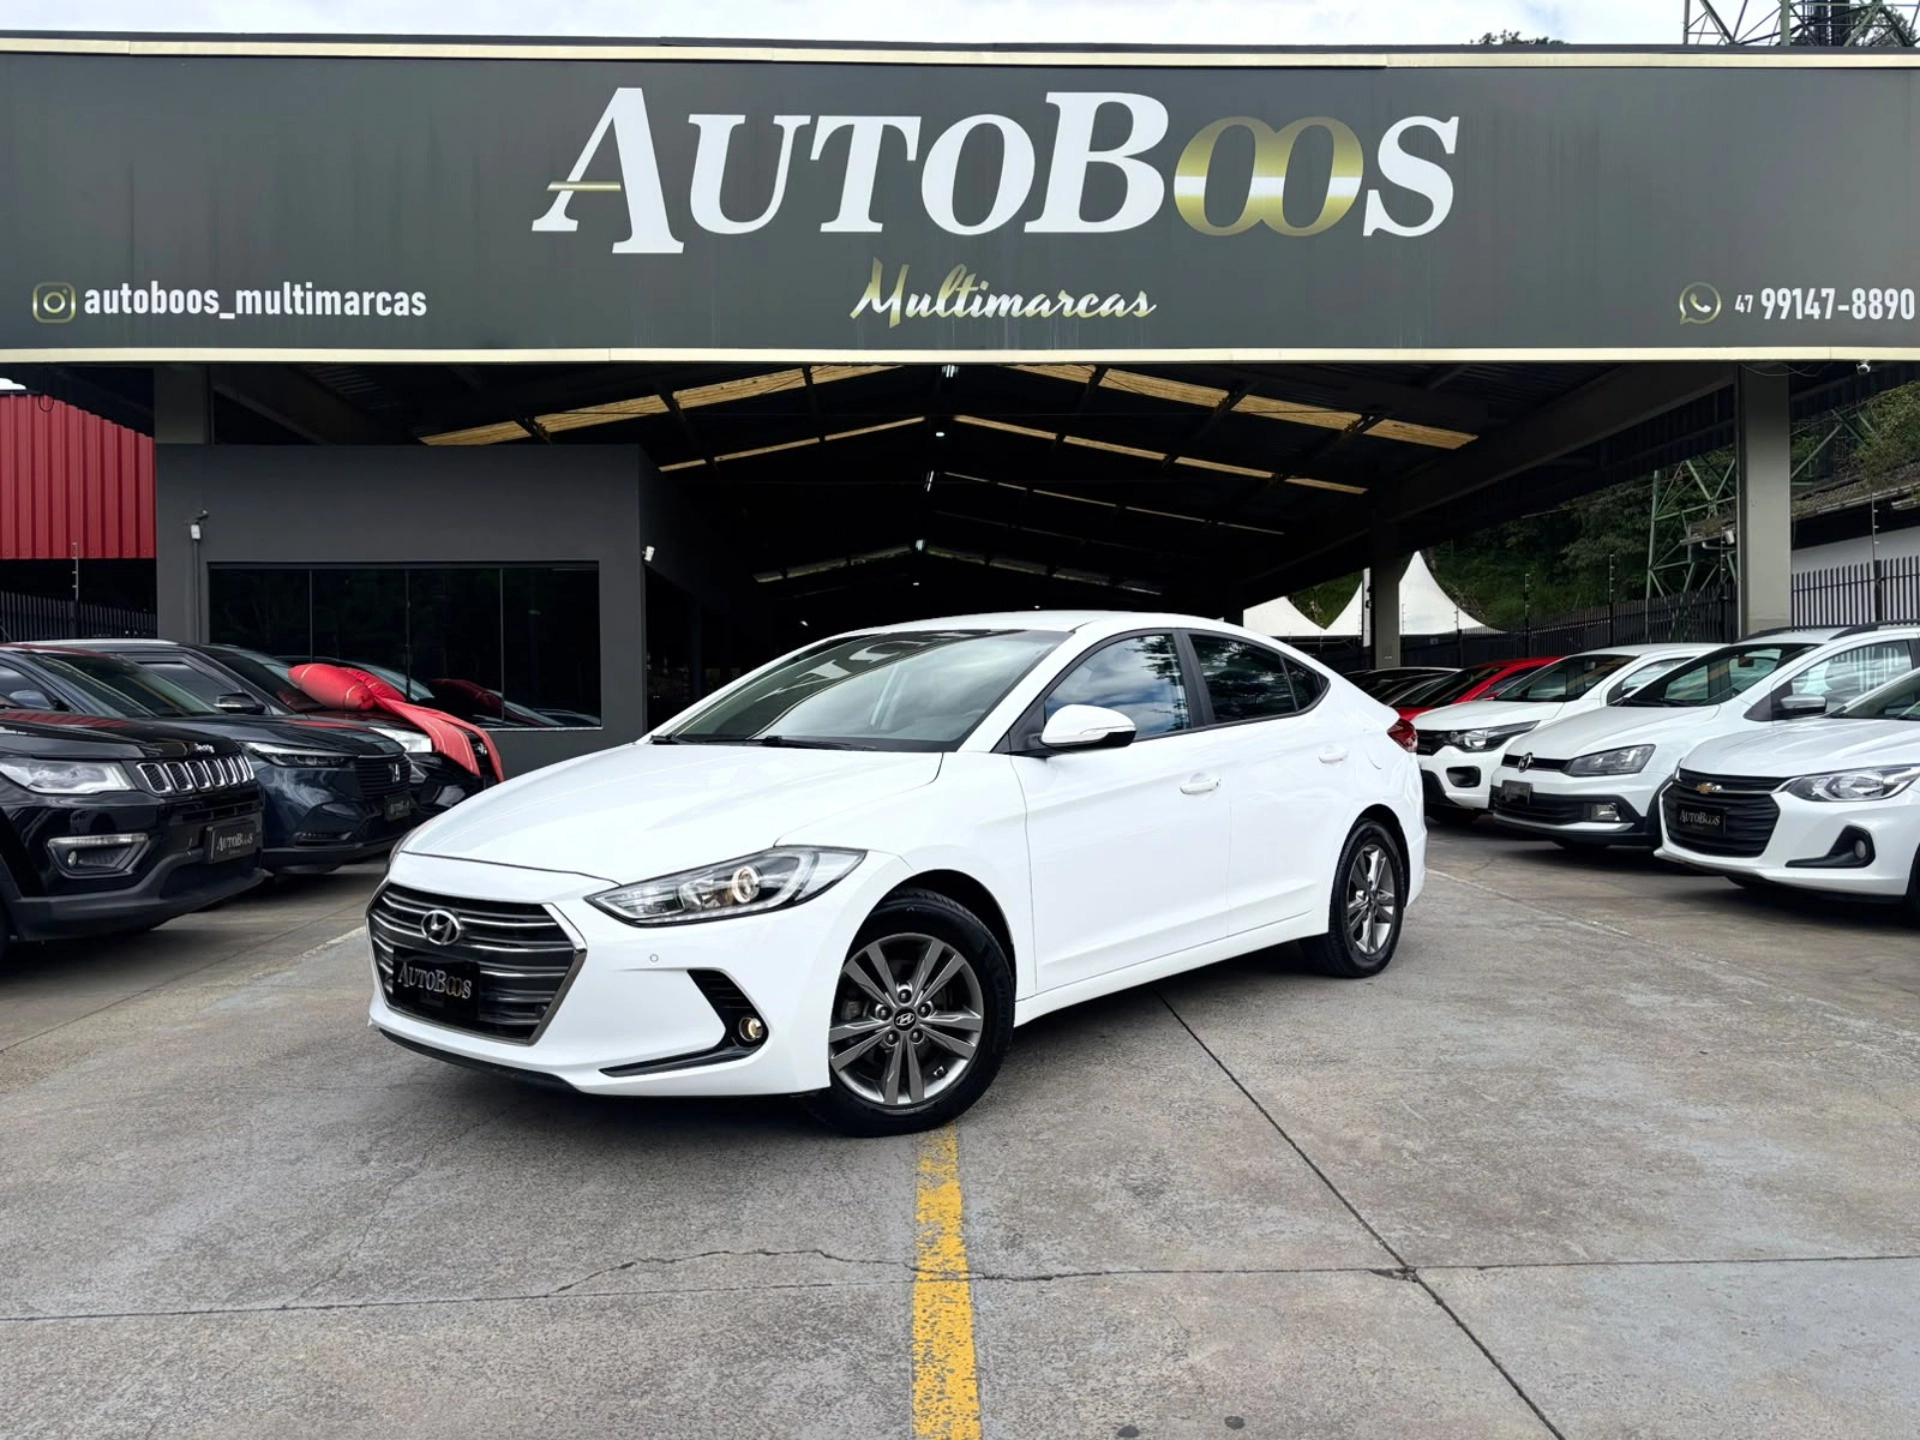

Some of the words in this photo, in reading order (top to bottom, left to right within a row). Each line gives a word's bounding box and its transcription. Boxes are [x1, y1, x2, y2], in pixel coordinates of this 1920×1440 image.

[84, 281, 427, 320] autoboos_multimarcas
[849, 256, 1158, 329] Multimarcas
[1734, 294, 1753, 313] 47
[1760, 288, 1915, 320] 99147-8890
